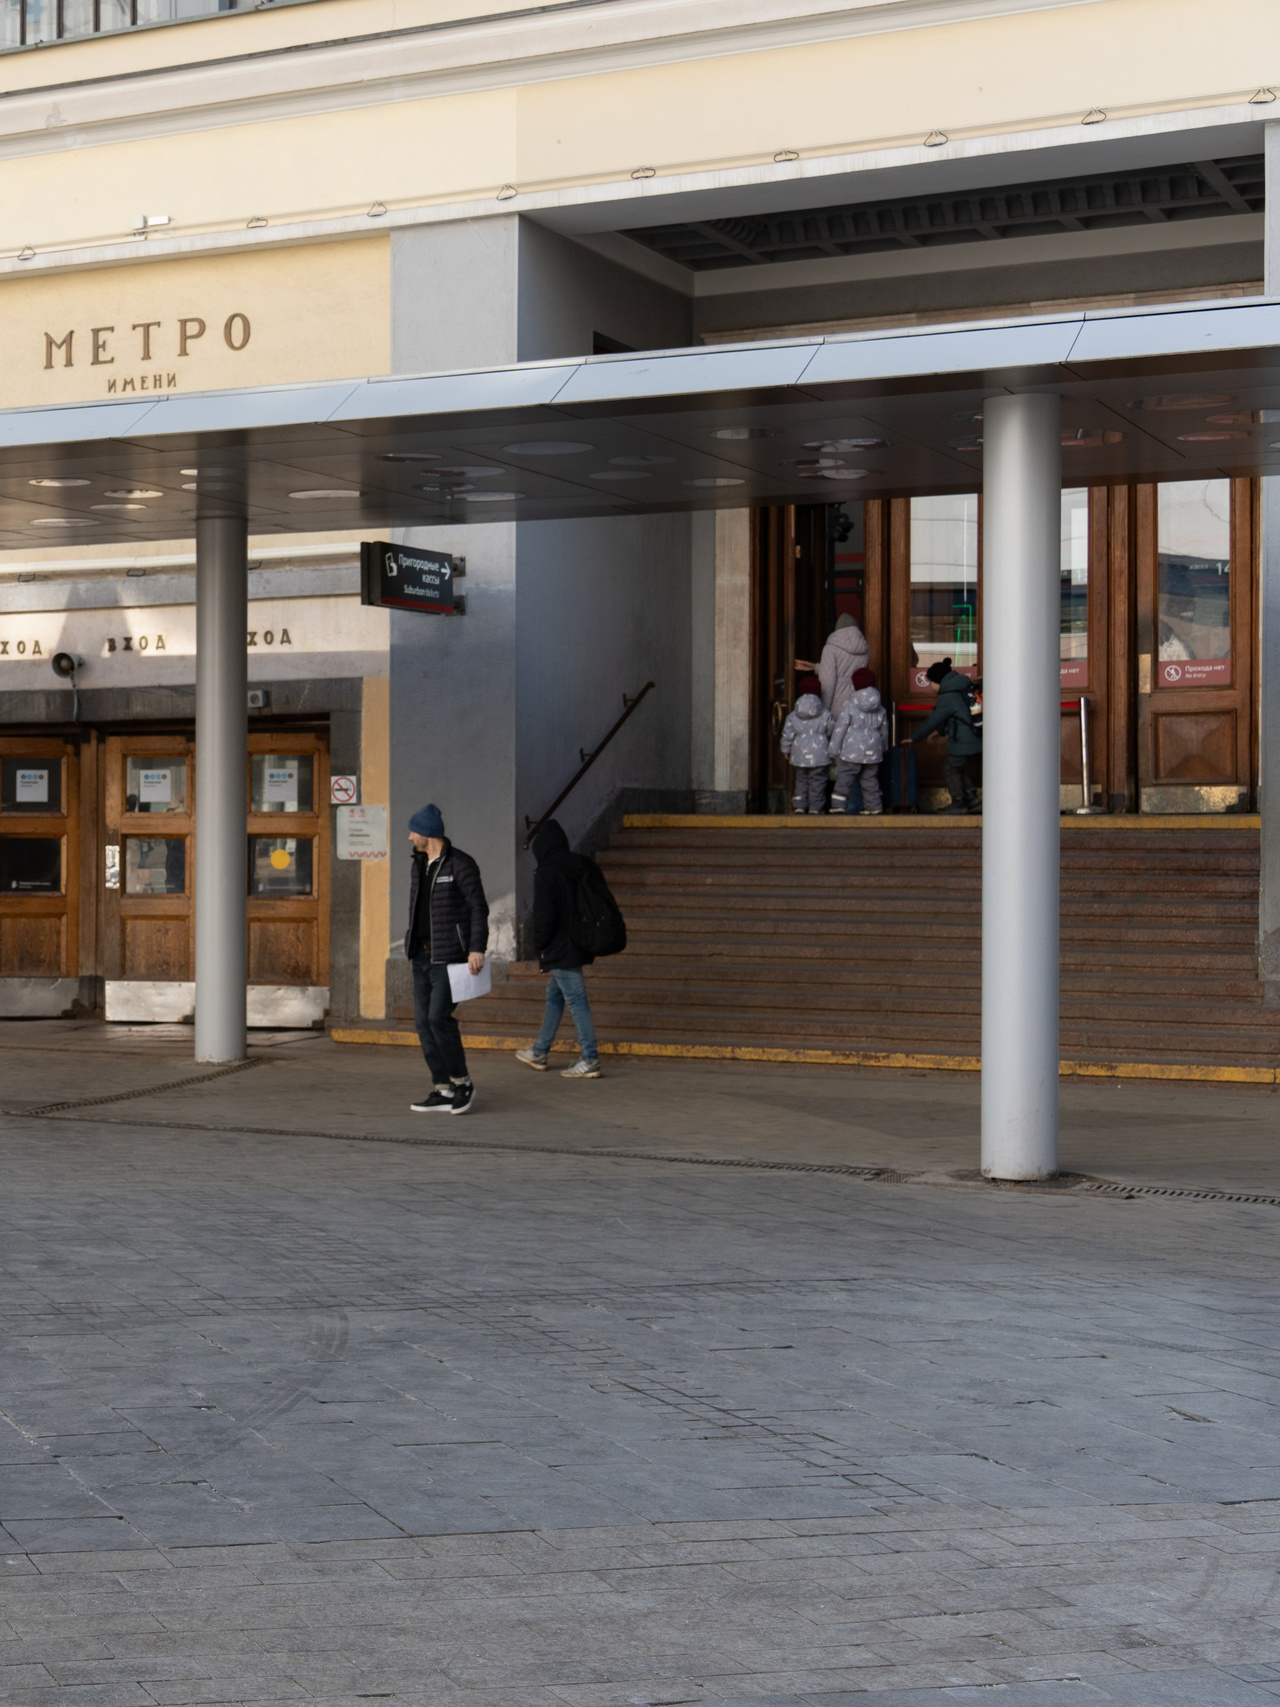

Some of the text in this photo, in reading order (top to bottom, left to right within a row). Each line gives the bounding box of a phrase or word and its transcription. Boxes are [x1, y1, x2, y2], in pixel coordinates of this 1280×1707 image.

[43, 312, 251, 369] МЕТРО
[107, 373, 177, 393] ИМЕНИ
[398, 553, 440, 571] Пригородные
[422, 574, 440, 585] кассы
[106, 634, 166, 652] ВХОД
[247, 628, 292, 647] ХОД
[1184, 664, 1213, 673] Прохода
